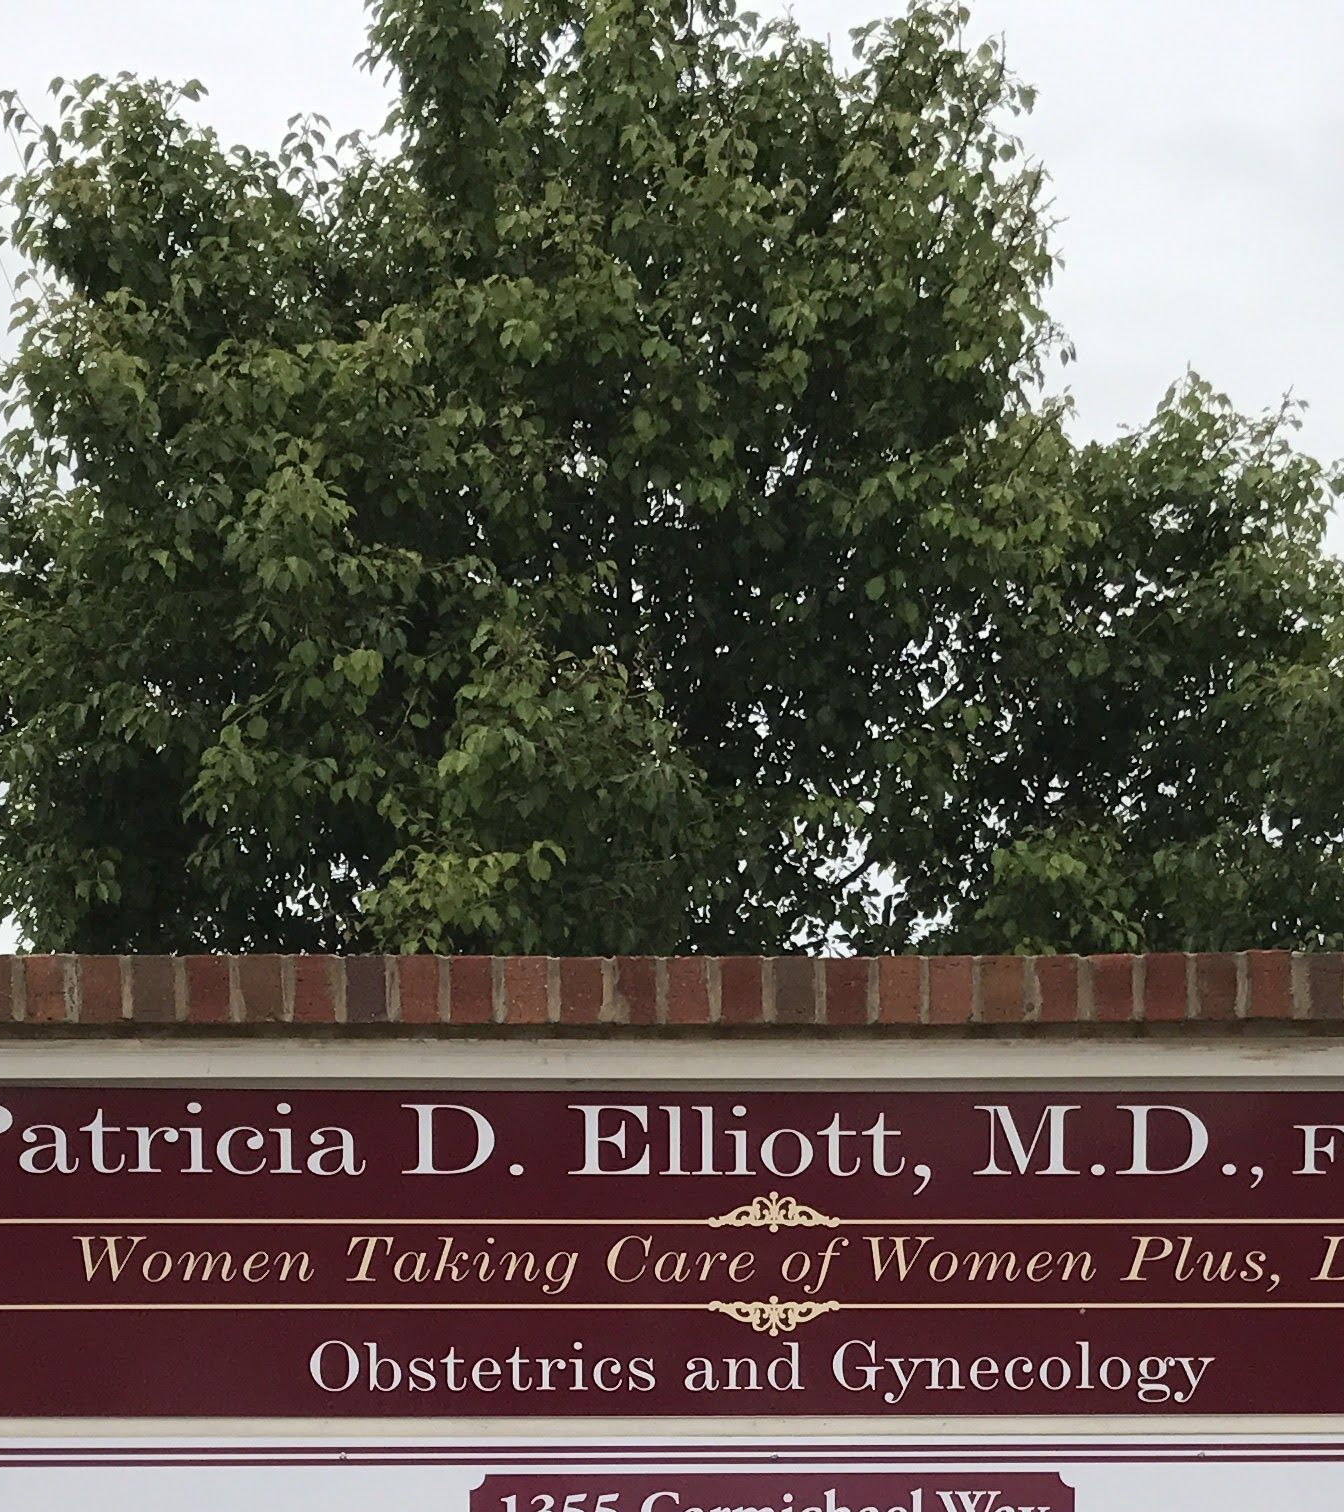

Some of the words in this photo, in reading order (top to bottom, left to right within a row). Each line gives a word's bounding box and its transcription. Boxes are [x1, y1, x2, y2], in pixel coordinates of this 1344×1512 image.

[400, 1103, 524, 1176] D.
[567, 1105, 932, 1196] Elliott,
[972, 1105, 1264, 1189] M.D.,
[72, 1235, 315, 1283] Women
[346, 1236, 579, 1295] Taking
[606, 1235, 756, 1283] Care
[781, 1236, 850, 1294] of
[862, 1236, 1097, 1282] Women
[1119, 1236, 1280, 1292] Plus,
[309, 1340, 656, 1392] Obstetrics
[684, 1341, 805, 1392] and
[832, 1339, 1216, 1404] Gynecology
